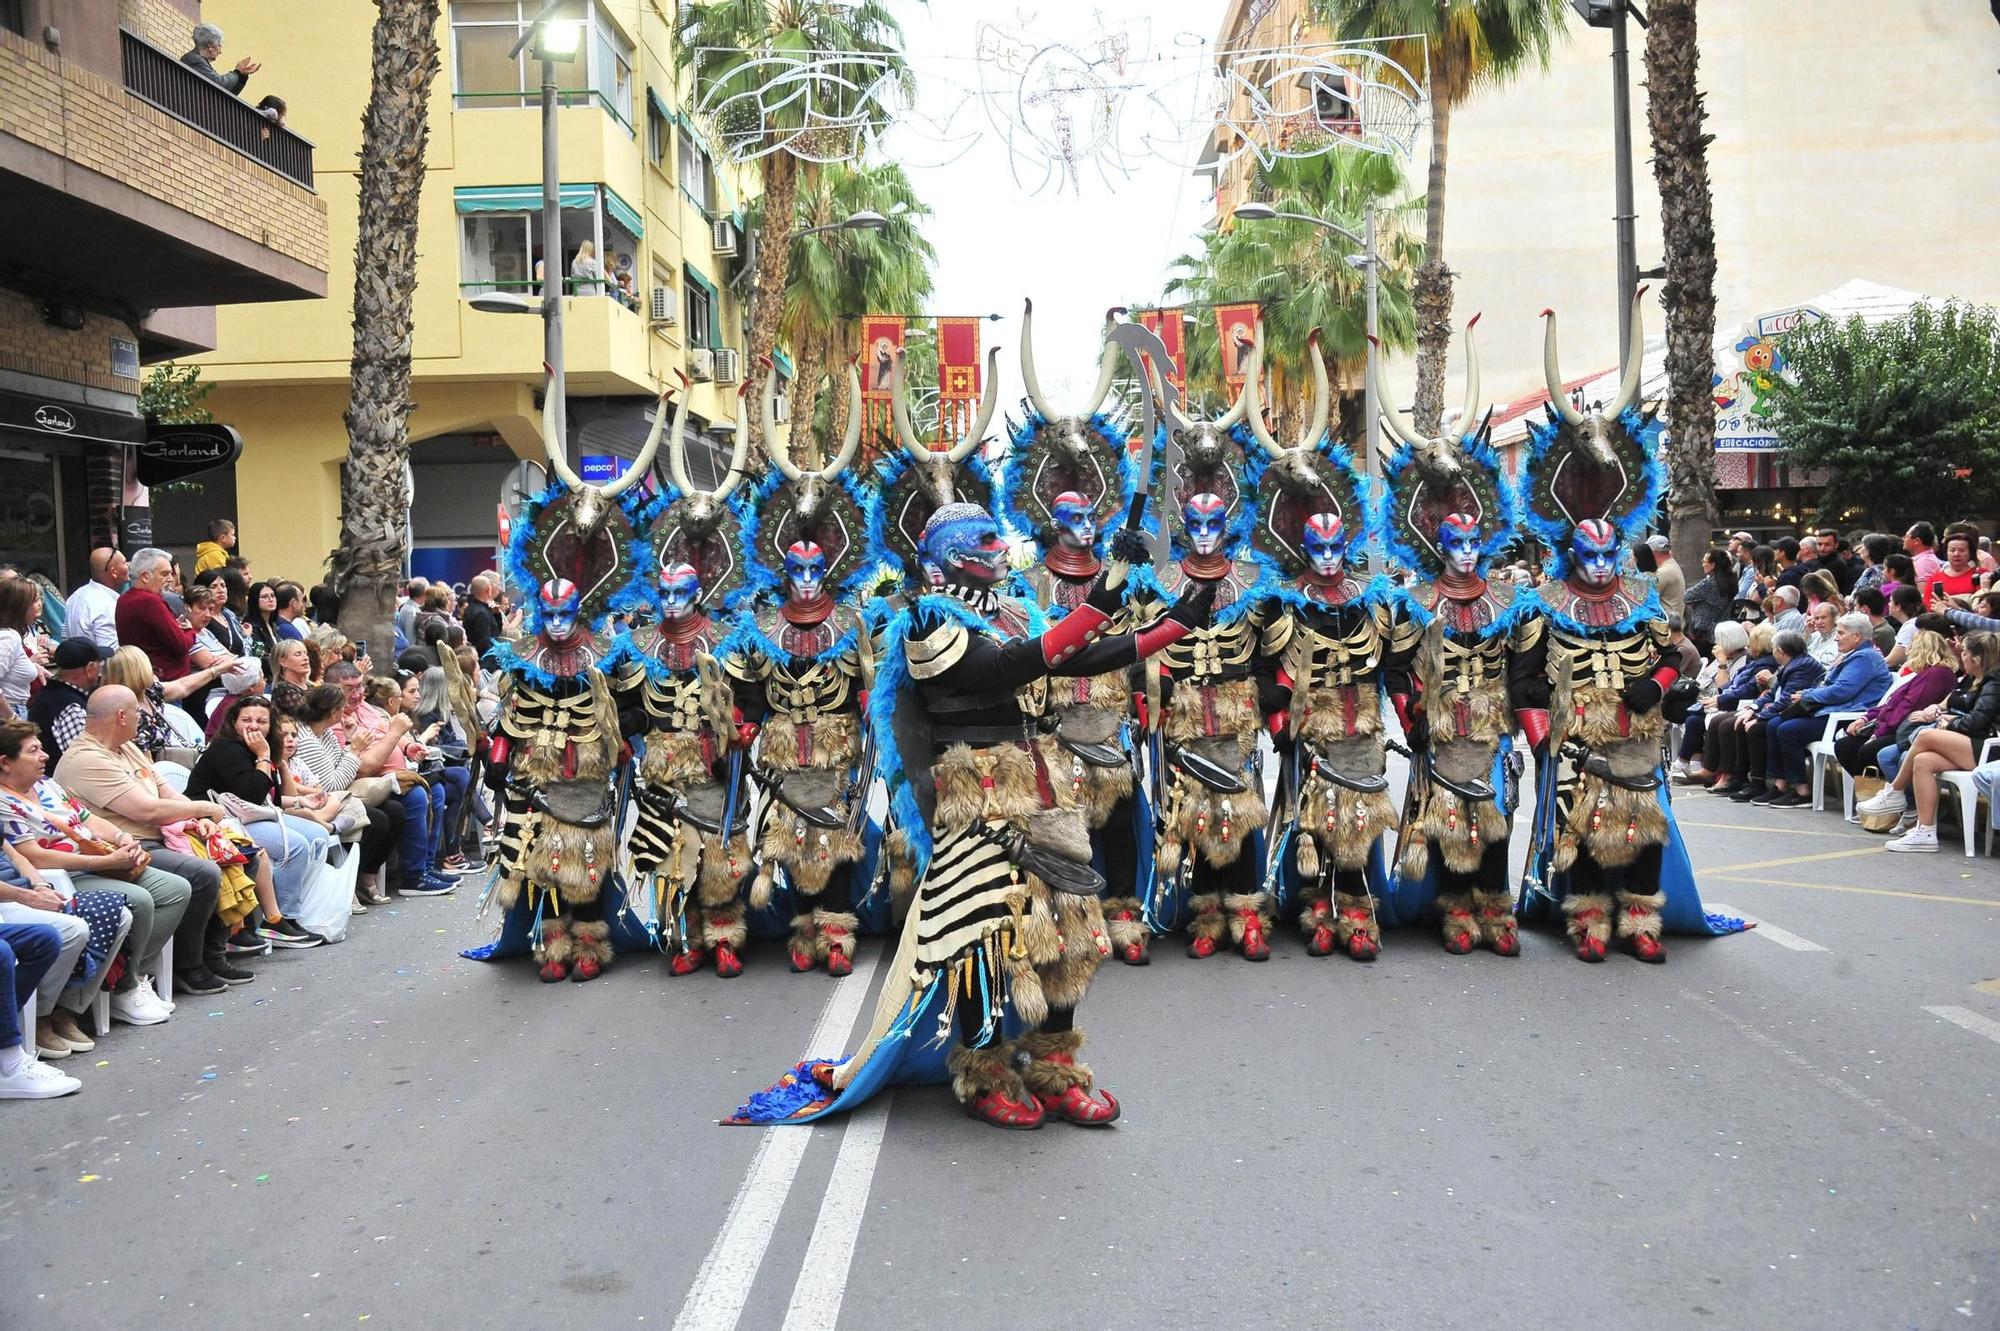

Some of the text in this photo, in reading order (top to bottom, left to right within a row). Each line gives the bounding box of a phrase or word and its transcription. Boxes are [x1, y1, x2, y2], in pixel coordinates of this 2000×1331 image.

[35, 410, 71, 428] Garland
[141, 441, 220, 456] Garland
[584, 464, 612, 472] pepco
